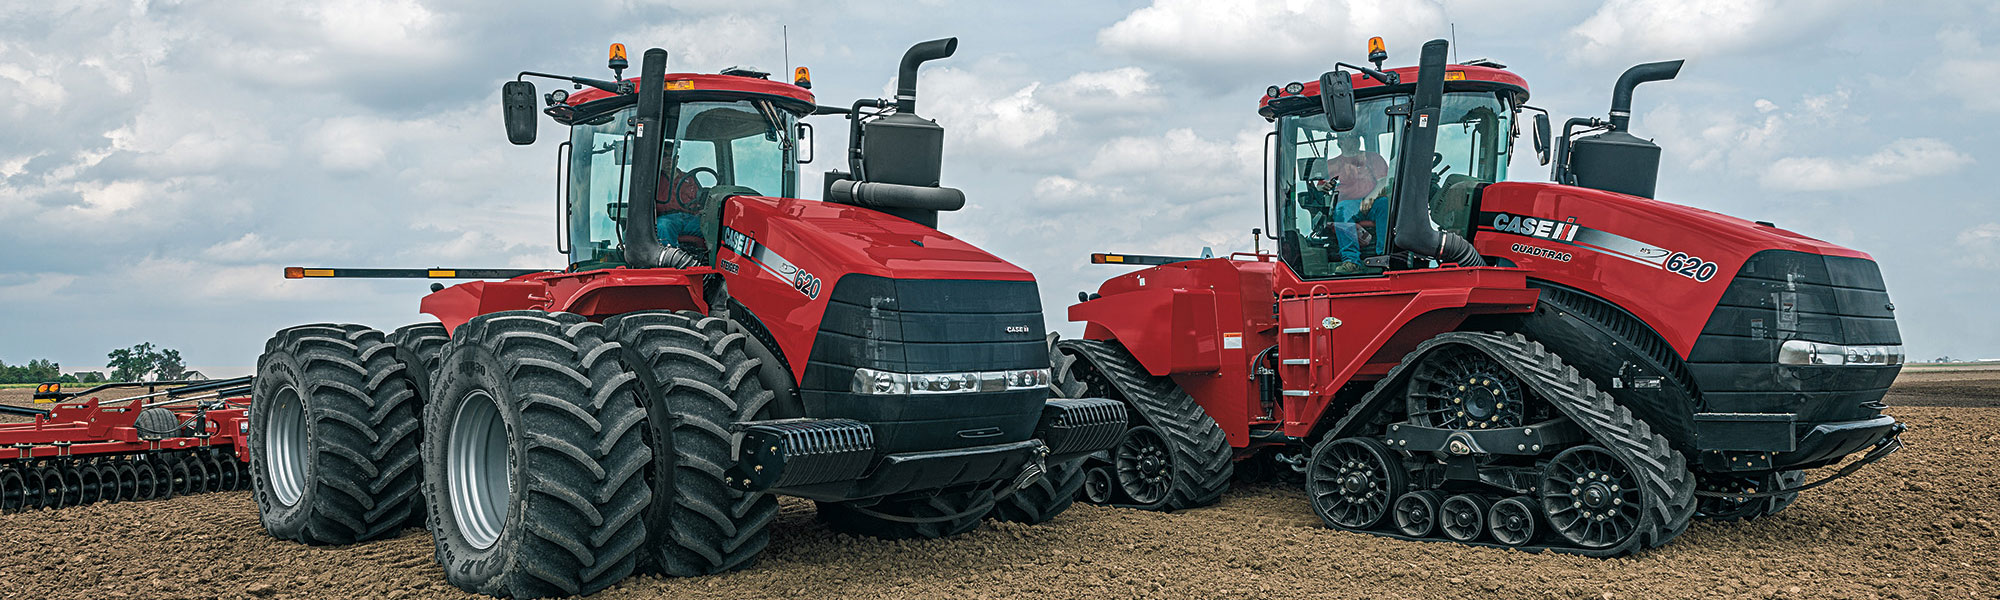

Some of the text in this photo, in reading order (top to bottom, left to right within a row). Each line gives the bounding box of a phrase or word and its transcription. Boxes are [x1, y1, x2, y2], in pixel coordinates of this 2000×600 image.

[1493, 213, 1555, 238] CASE
[725, 227, 745, 252] CASE
[1511, 242, 1572, 262] QUADTRAC
[1666, 251, 1718, 283] 620
[795, 269, 821, 300] 620
